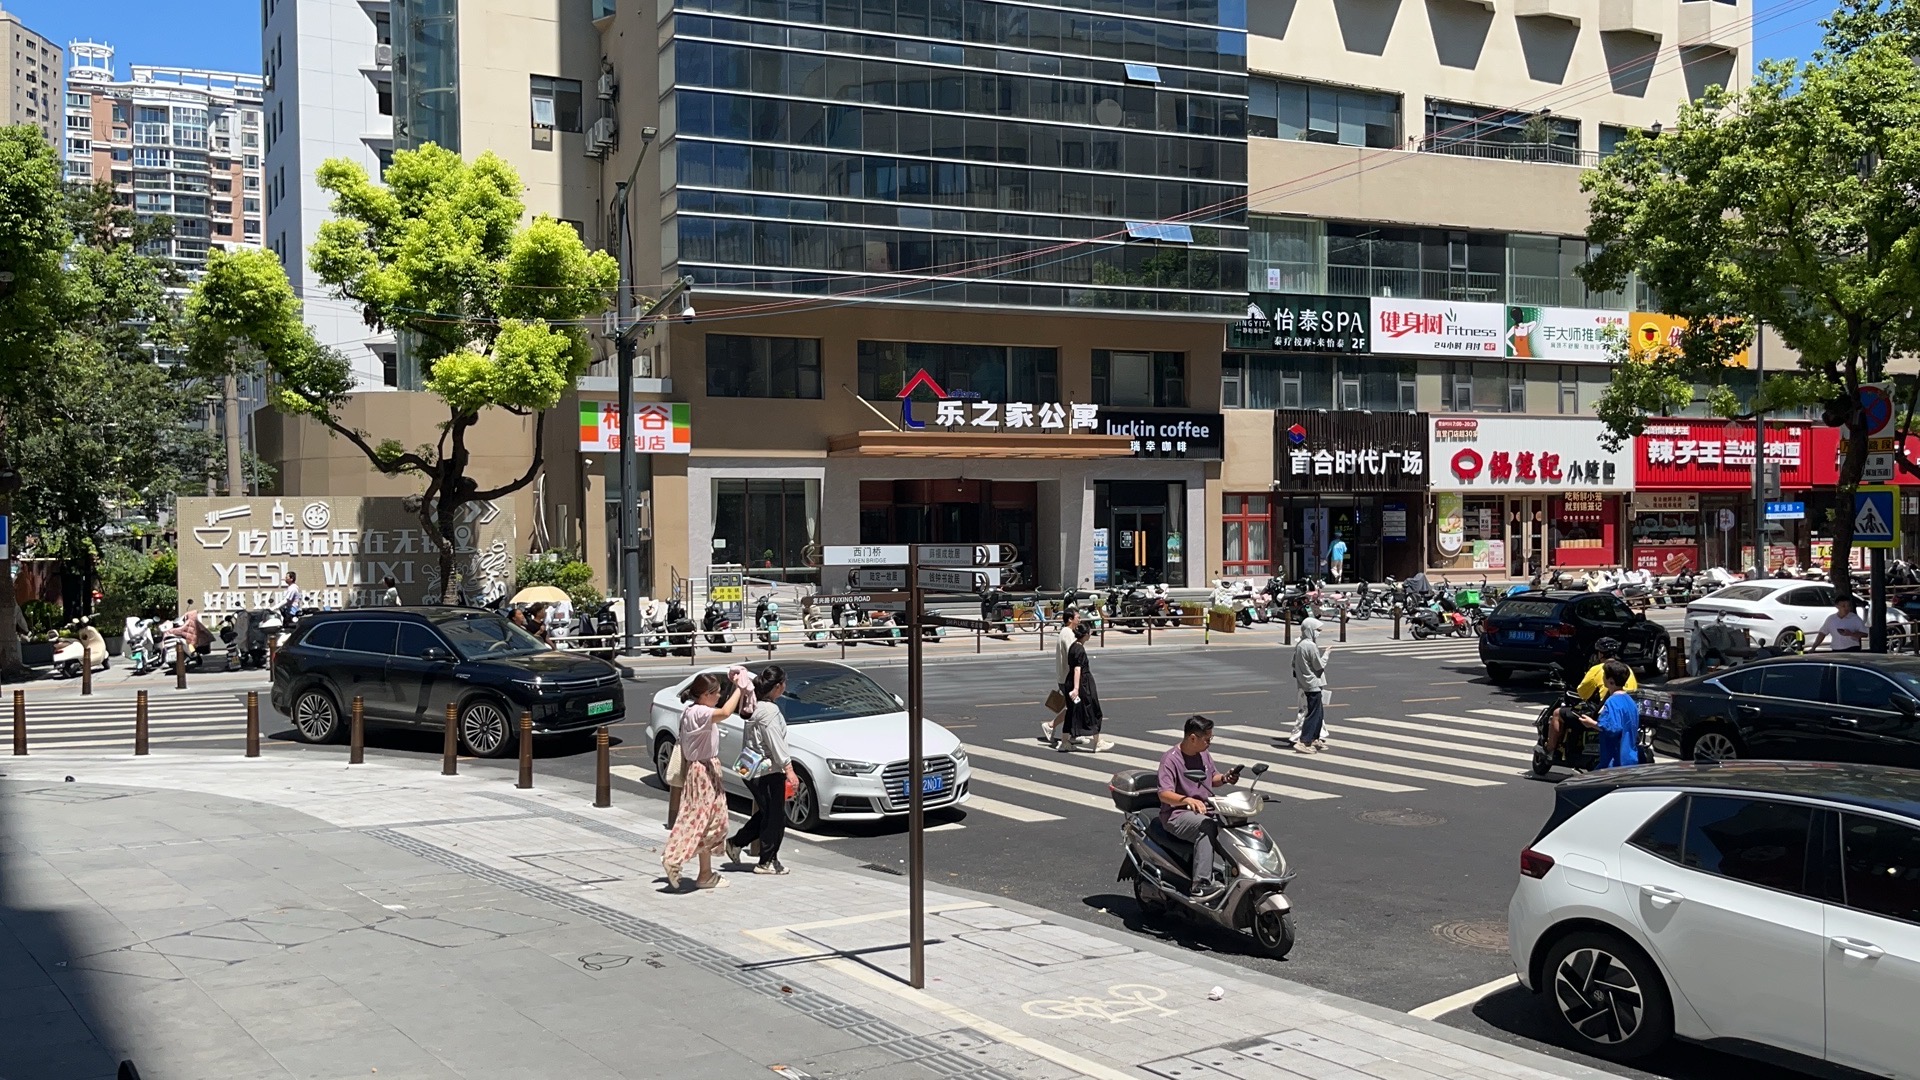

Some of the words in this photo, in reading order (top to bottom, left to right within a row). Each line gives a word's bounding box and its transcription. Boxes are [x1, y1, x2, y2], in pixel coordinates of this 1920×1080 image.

[1274, 307, 1364, 334] 怡泰SPA
[1379, 310, 1443, 338] 健身树
[1446, 324, 1497, 337] Fitness
[1352, 338, 1366, 349] 2F
[935, 400, 1099, 430] 乐之家公寓
[1106, 419, 1155, 437] luckin
[1160, 421, 1209, 438] coffee
[1130, 440, 1187, 452] 瑞幸咖啡
[1648, 439, 1722, 464] 辣子王
[1289, 448, 1423, 476] 首合时代广场
[1567, 459, 1616, 480] 小笼包
[853, 547, 882, 557] 西门桥
[212, 561, 289, 588] YES!
[323, 560, 415, 586] WUXI
